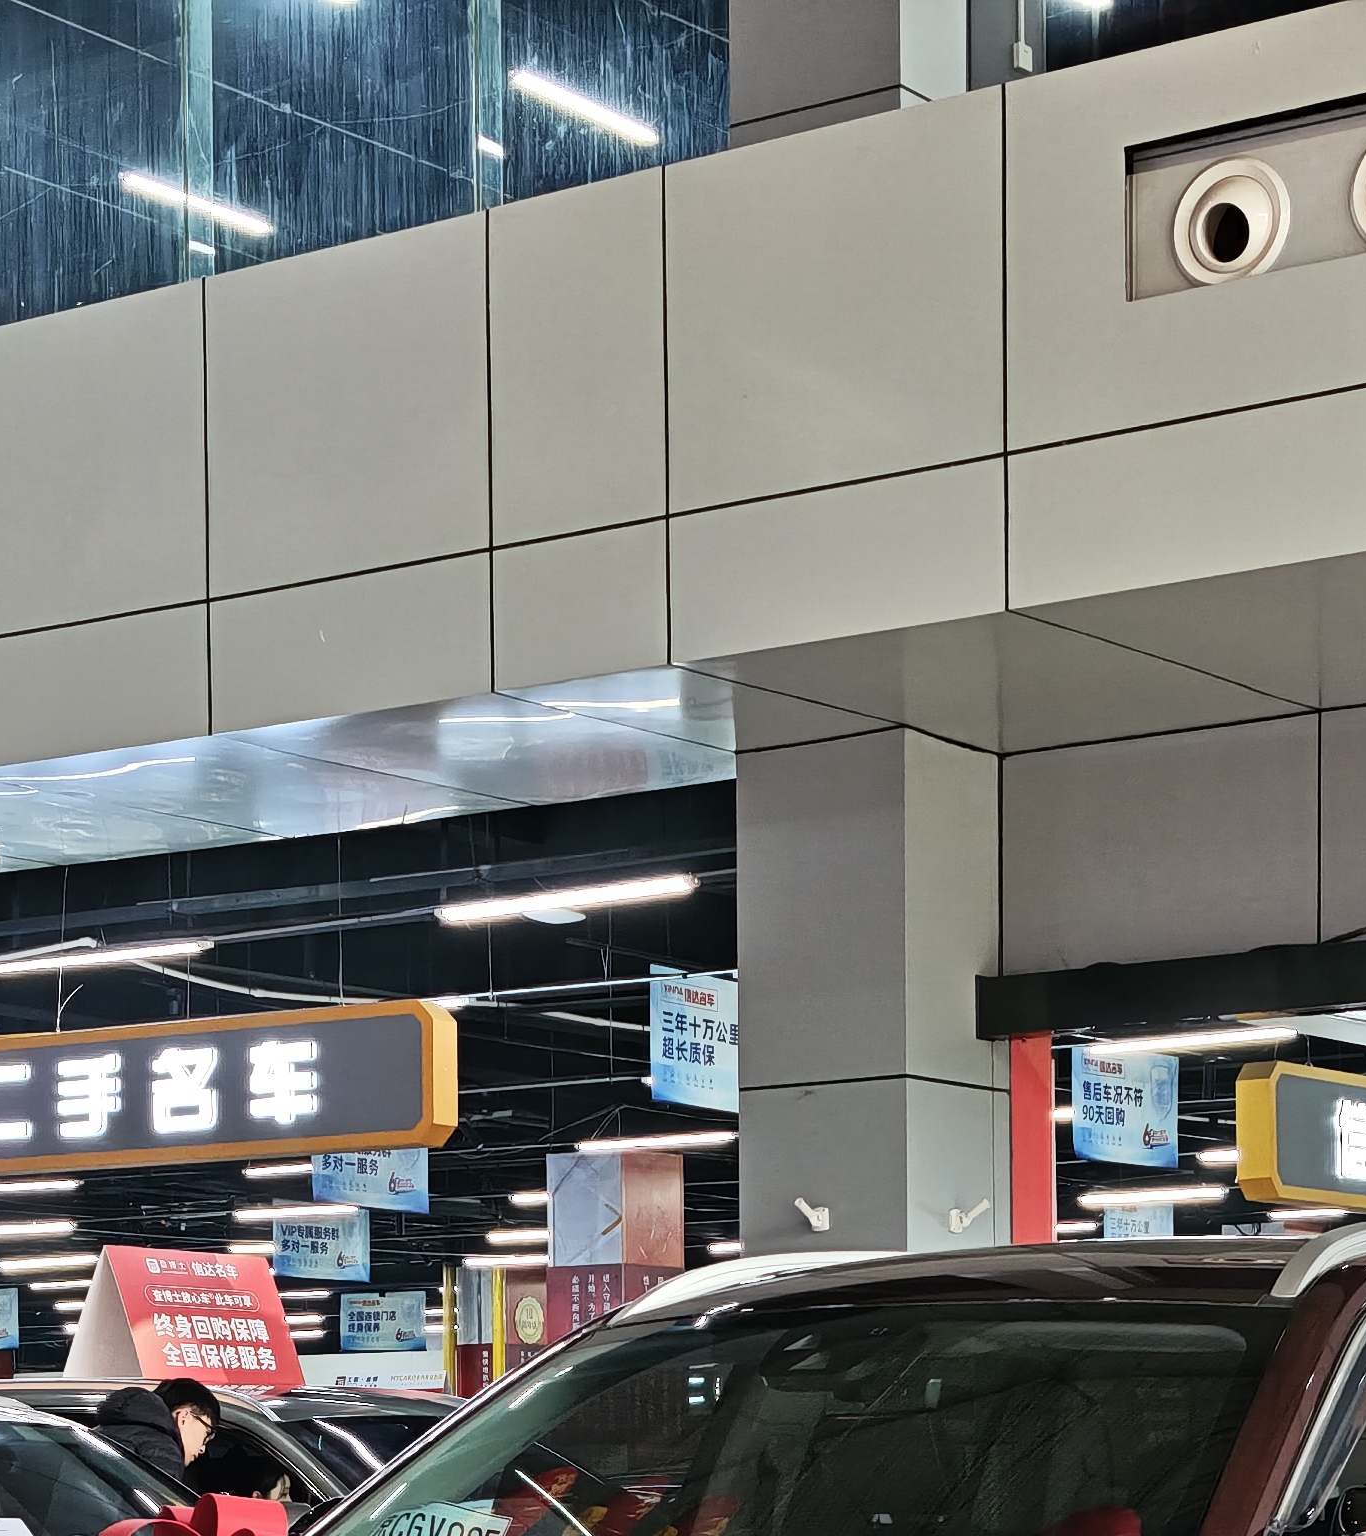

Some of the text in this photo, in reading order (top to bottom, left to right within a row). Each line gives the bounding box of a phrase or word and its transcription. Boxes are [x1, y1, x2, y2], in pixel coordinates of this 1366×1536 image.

[662, 1010, 739, 1046] 三年十万公里
[662, 1036, 716, 1067] 超长质保
[1082, 1080, 1144, 1108] 售后车况不符
[1082, 1104, 1126, 1127] 90天回购
[321, 1153, 379, 1177] 多对一服务
[191, 1261, 239, 1280] 信达名车
[153, 1312, 271, 1344] 终身回购保障
[162, 1341, 278, 1372] 全国保修服务
